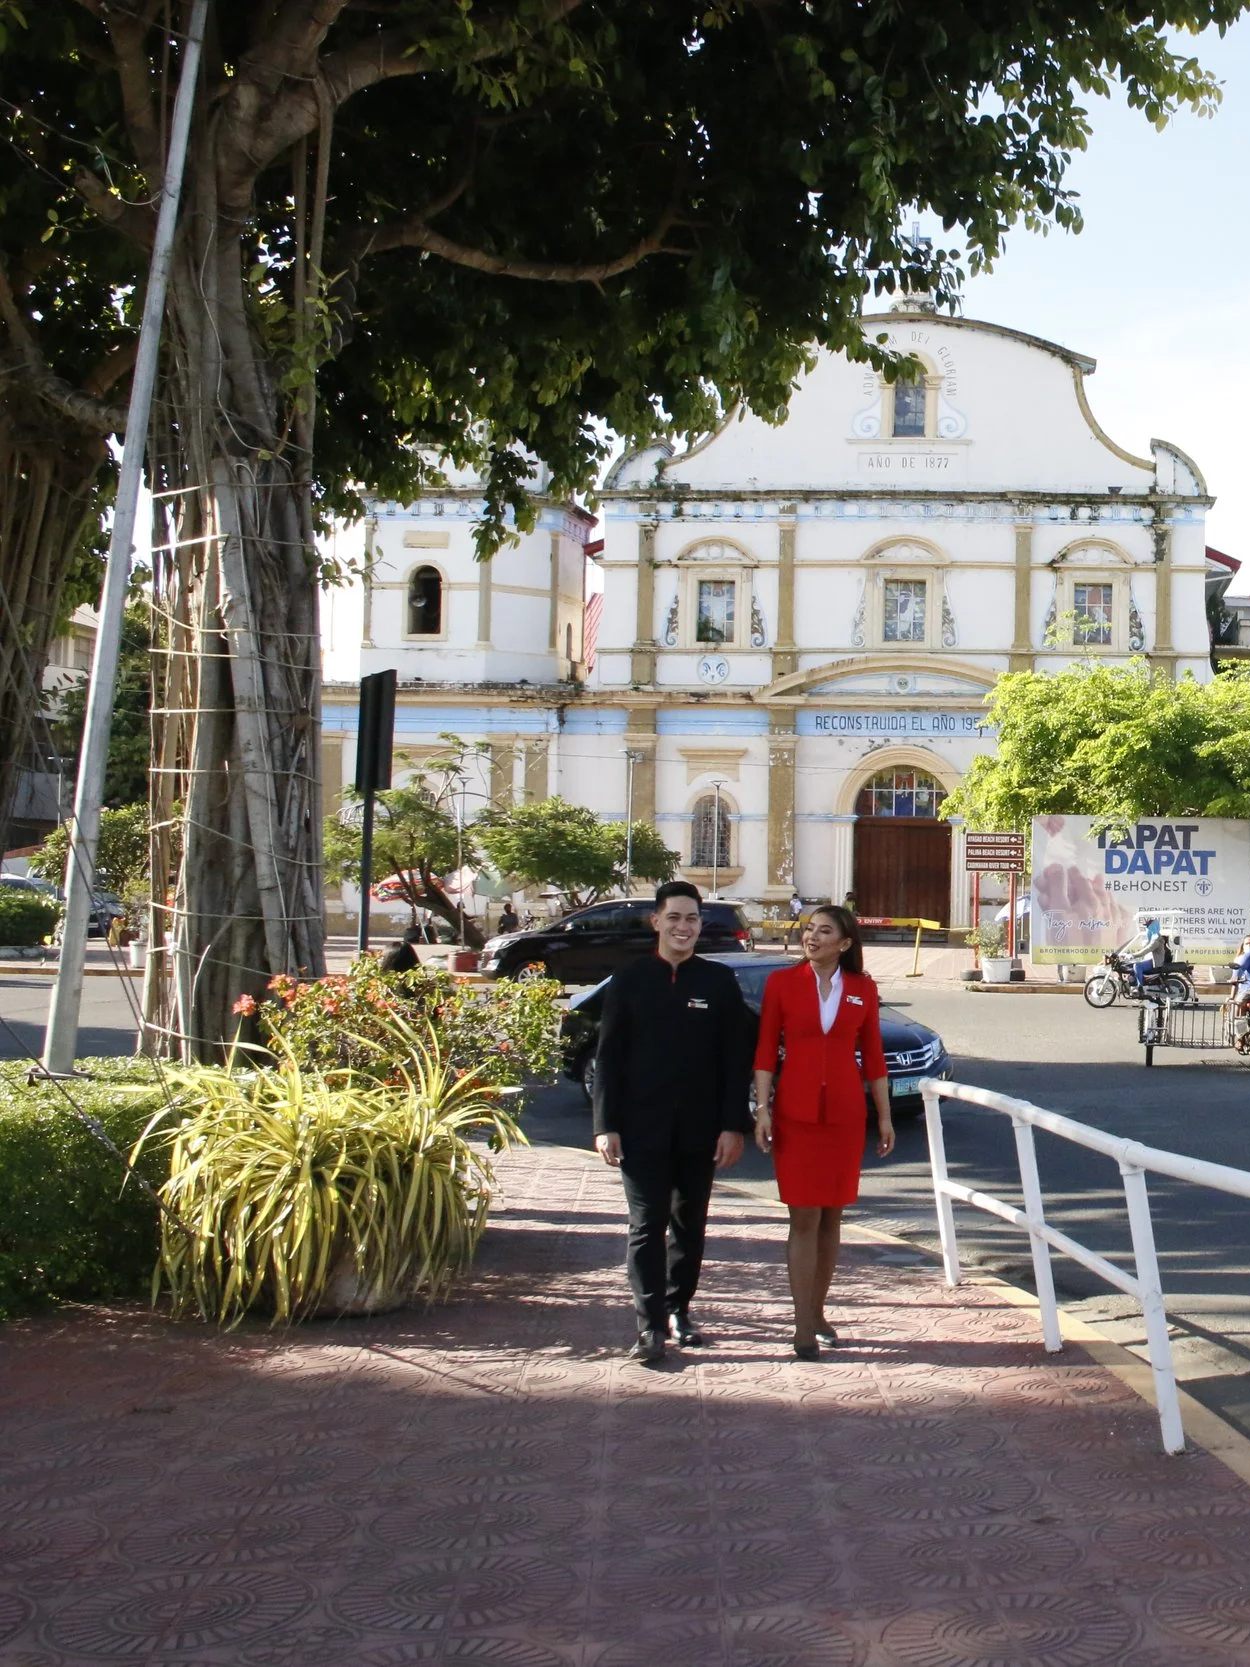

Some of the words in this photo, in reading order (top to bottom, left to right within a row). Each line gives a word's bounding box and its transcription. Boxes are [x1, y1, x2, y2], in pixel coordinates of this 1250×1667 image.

[911, 331, 930, 345] DEI
[937, 346, 957, 396] GLORIAM
[868, 455, 891, 468] AÑO
[901, 457, 916, 468] DE
[925, 456, 949, 469] 1877
[815, 715, 907, 730] RECONSTRUIDA
[911, 716, 925, 731] EL
[932, 714, 956, 731] AÑO
[1090, 824, 1200, 850] TAPAT
[1104, 849, 1217, 876] DAPAT
[1104, 880, 1188, 893] #BeHONEST
[1227, 908, 1244, 916] NOT
[1228, 918, 1247, 926] NOT
[1207, 927, 1226, 935] CAN
